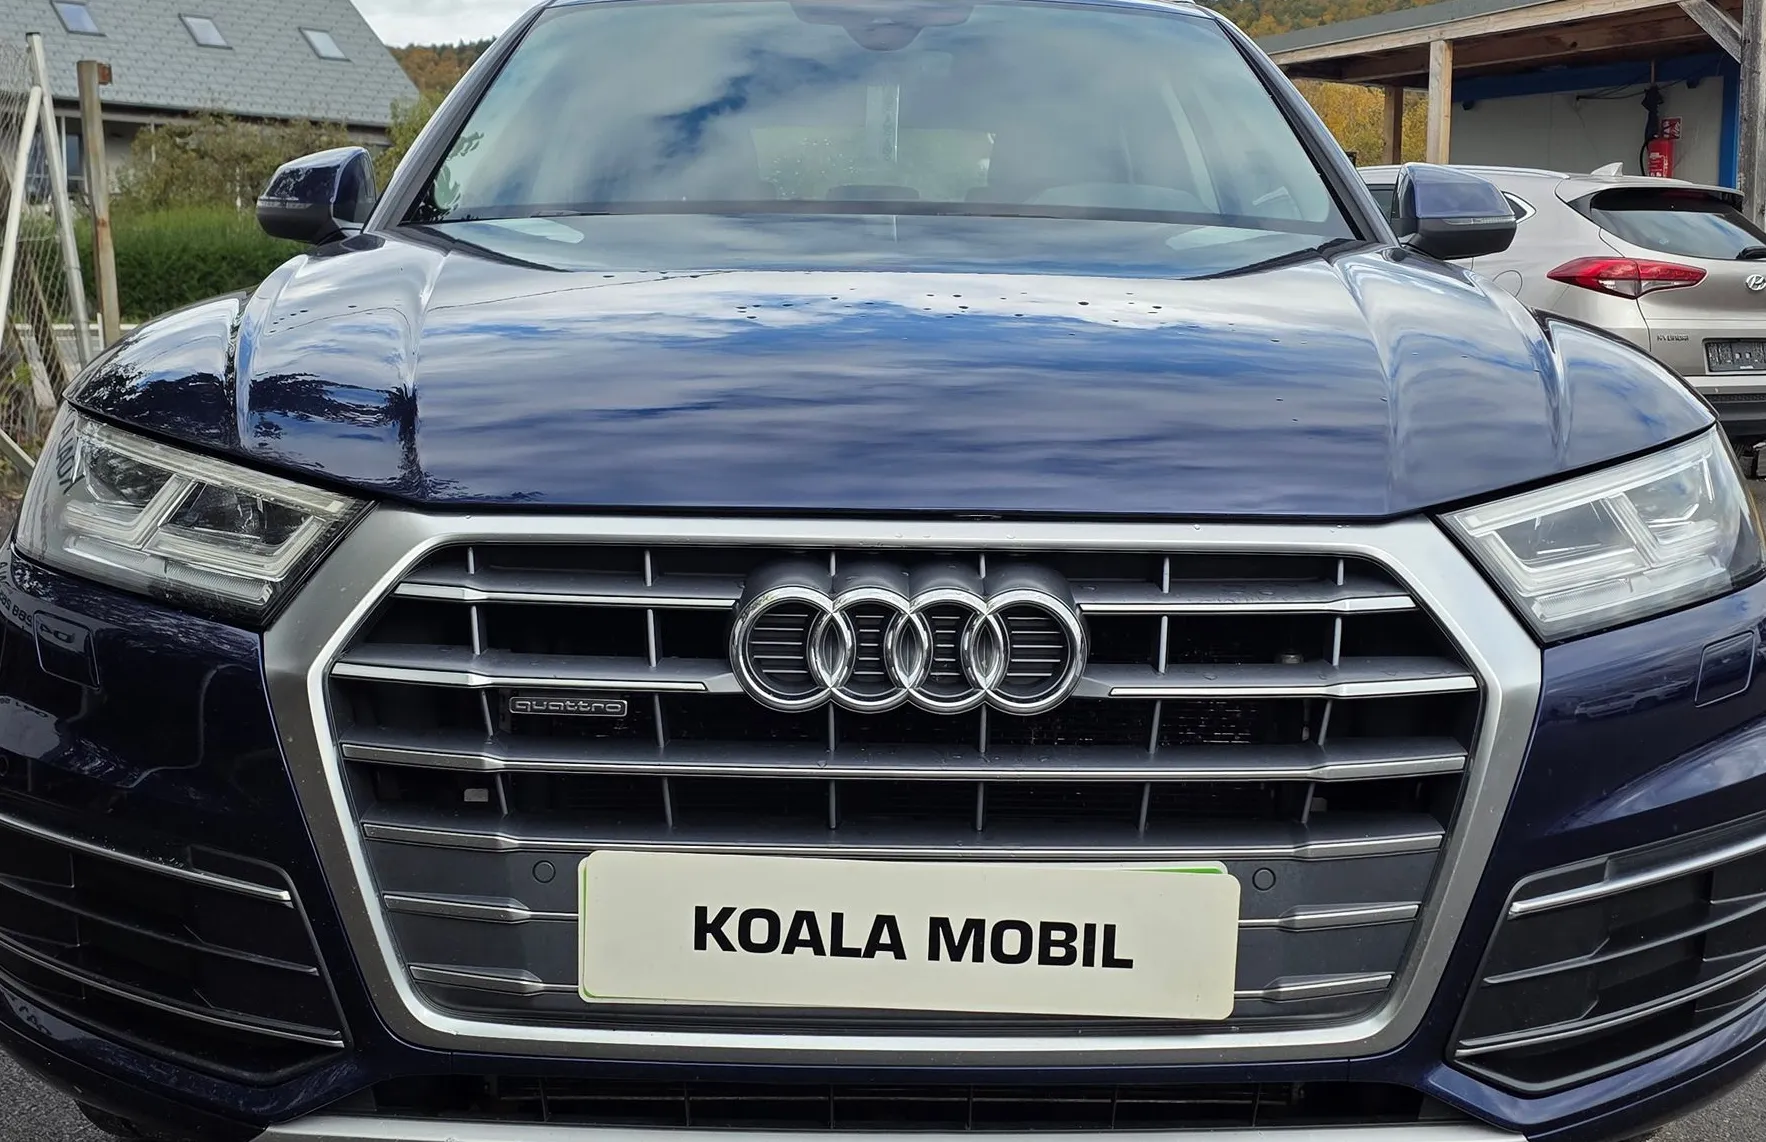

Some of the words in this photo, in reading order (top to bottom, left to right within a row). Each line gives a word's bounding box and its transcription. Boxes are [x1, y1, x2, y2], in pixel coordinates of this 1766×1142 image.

[514, 700, 622, 712] quattro
[694, 905, 907, 961] KOALA
[927, 916, 1134, 969] MOBIL
